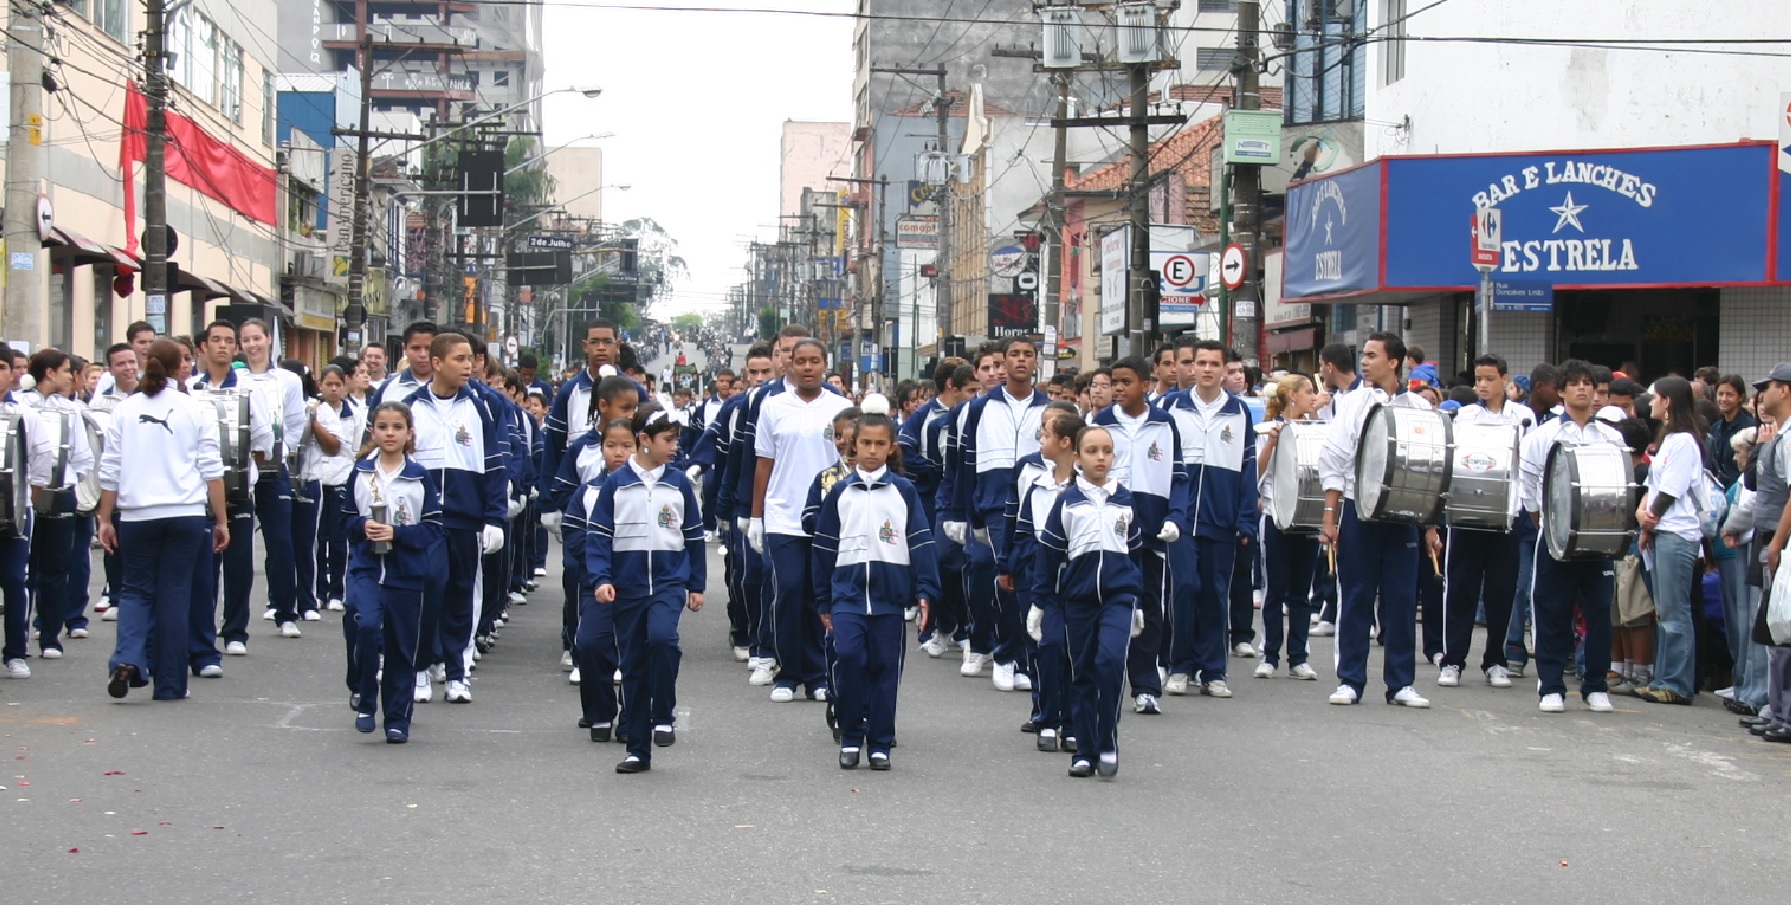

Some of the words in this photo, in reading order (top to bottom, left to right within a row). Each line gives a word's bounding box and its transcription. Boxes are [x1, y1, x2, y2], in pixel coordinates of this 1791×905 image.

[1472, 174, 1520, 209] BAR
[1522, 166, 1540, 190] E
[1544, 160, 1657, 208] LANCHES
[536, 238, 547, 247] de
[547, 238, 571, 248] Julho
[1501, 238, 1640, 273] ESTRELA
[1172, 261, 1185, 280] E
[994, 326, 1029, 337] Horas
